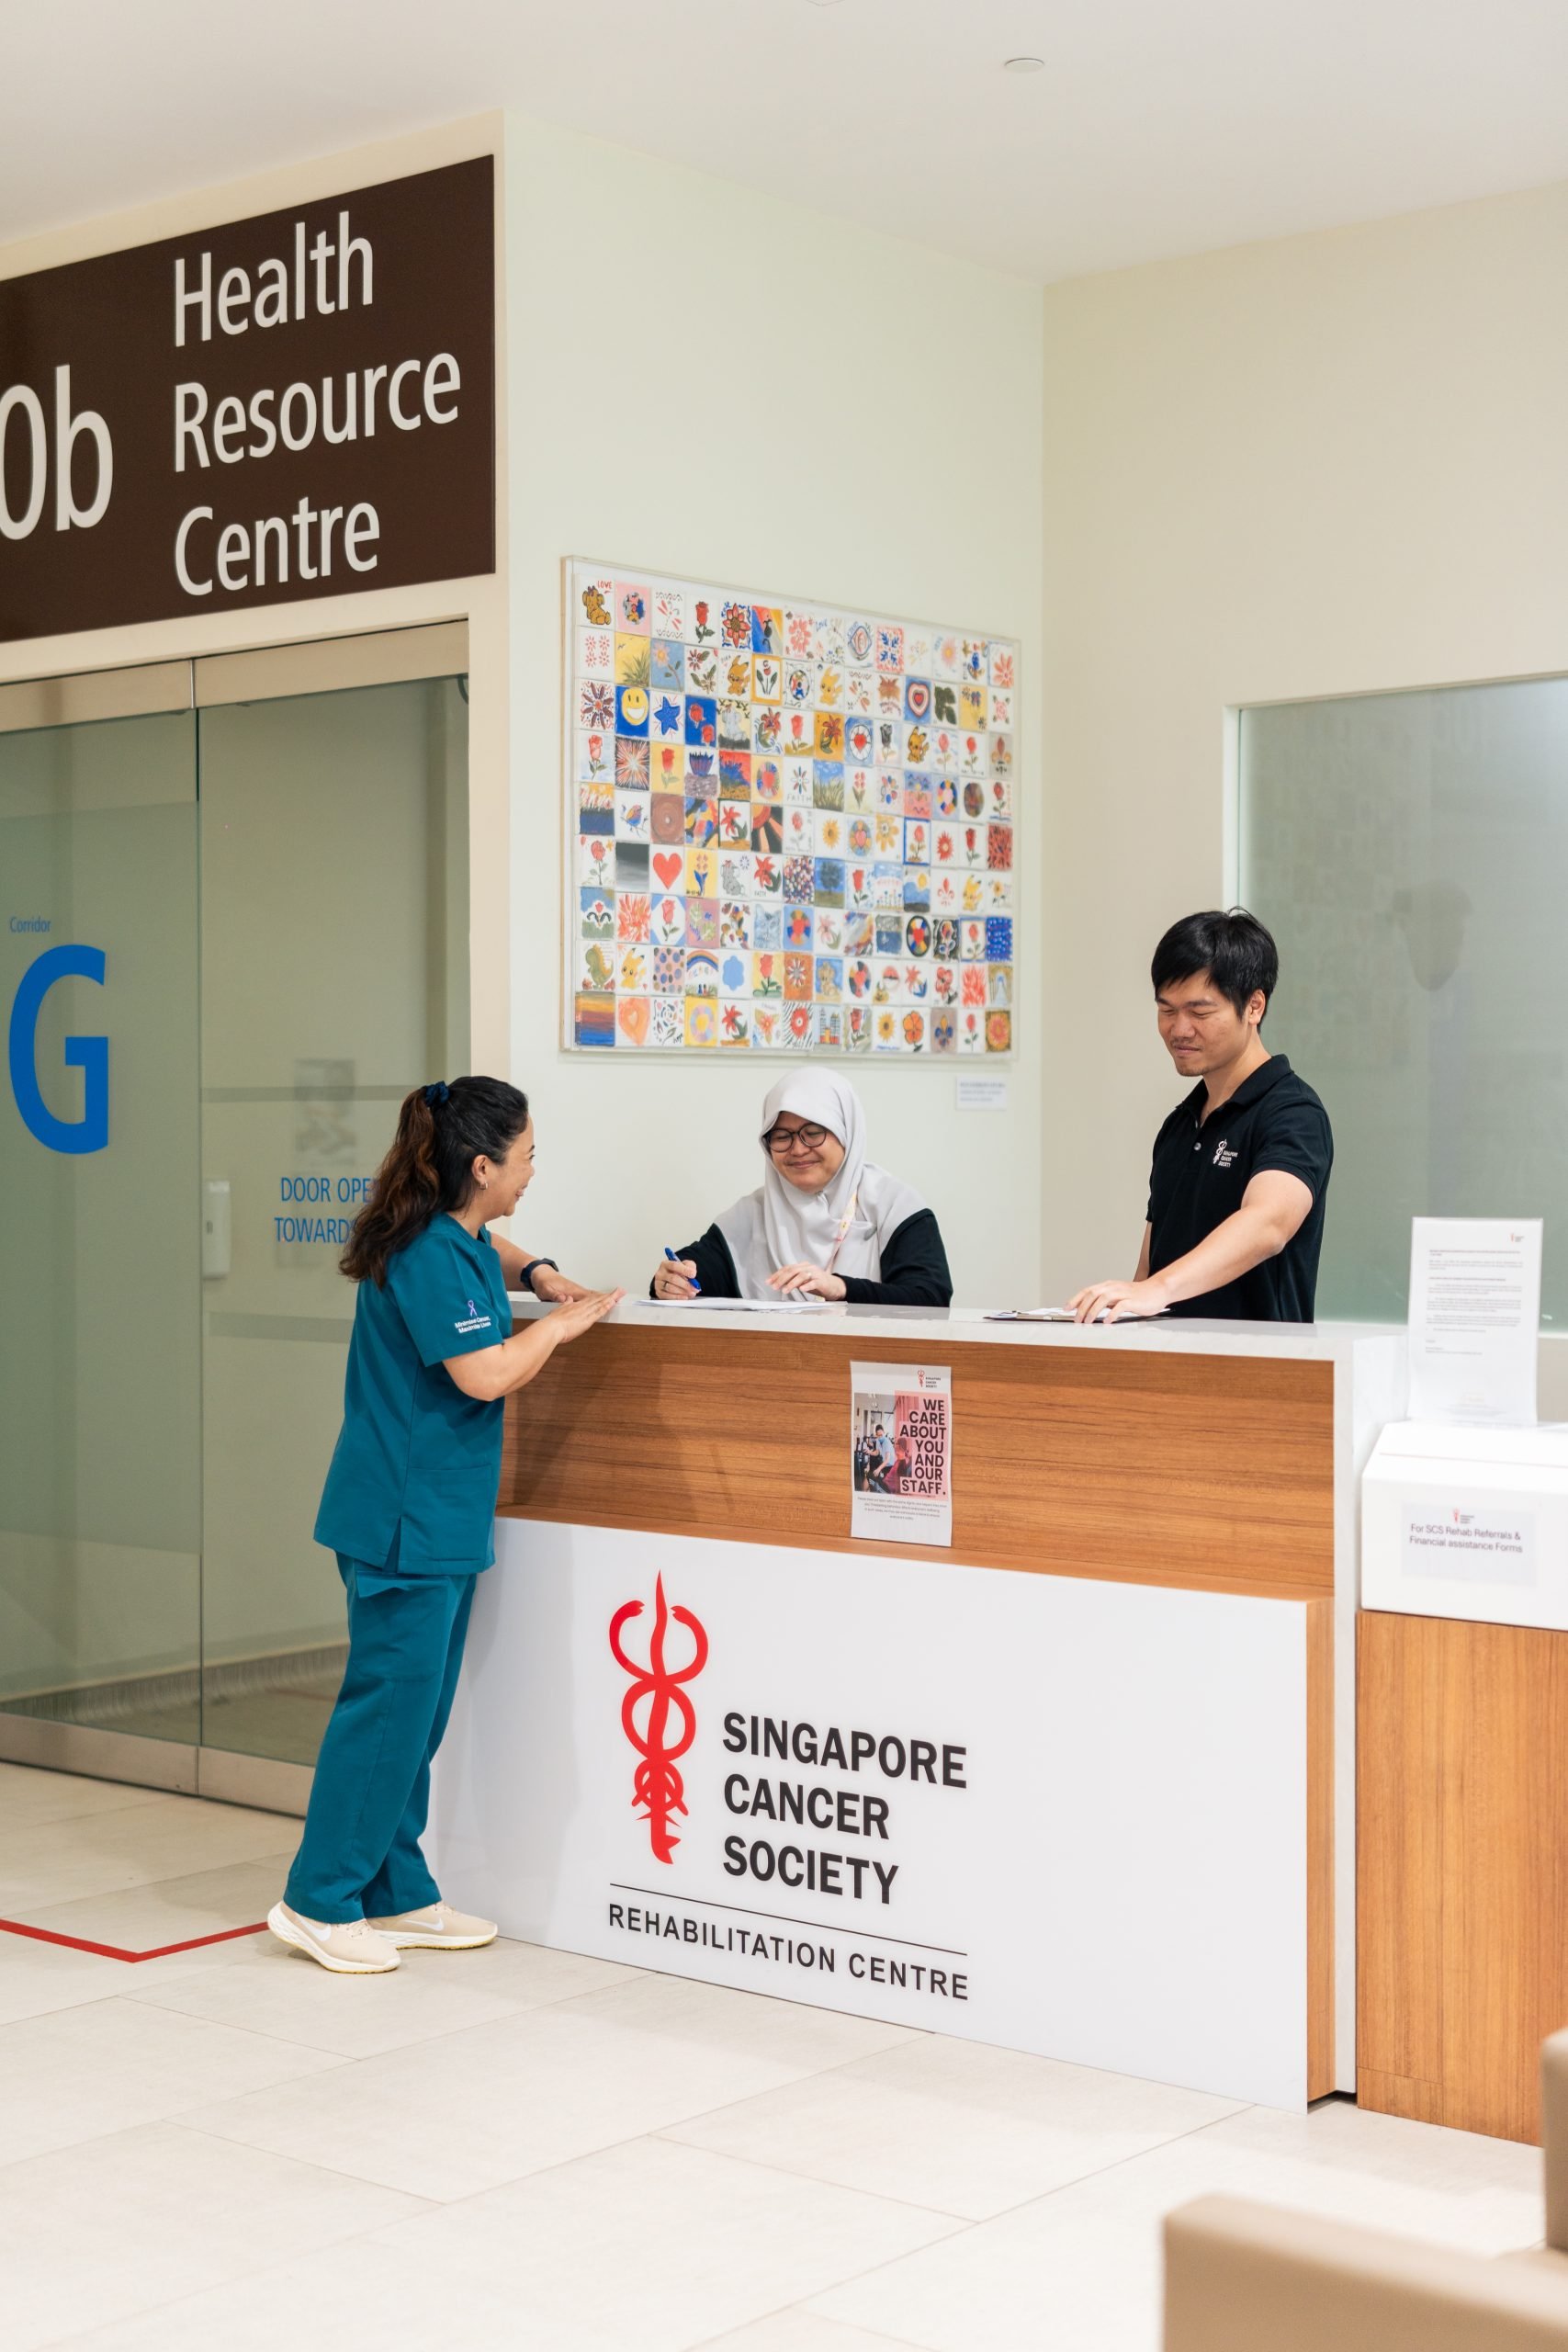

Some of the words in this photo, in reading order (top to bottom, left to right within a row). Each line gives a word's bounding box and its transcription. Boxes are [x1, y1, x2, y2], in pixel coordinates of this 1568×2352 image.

[175, 211, 373, 347] Health
[175, 353, 461, 472] Resource
[175, 497, 380, 595] Centre
[597, 581, 613, 589] LOVE
[9, 916, 51, 933] Corridor
[9, 944, 108, 1155] G
[281, 1177, 331, 1203] DOOR
[337, 1178, 376, 1204] OPE
[923, 1398, 944, 1411] WE
[908, 1411, 945, 1425] CARE
[900, 1424, 946, 1440] ABOUT
[915, 1440, 943, 1453] YOU
[915, 1453, 943, 1467] AND
[915, 1466, 942, 1481] OUR
[901, 1479, 946, 1495] STAFF.
[1411, 1523, 1423, 1533] For
[1426, 1524, 1444, 1534] SCS
[1445, 1526, 1472, 1537] Rehab
[1474, 1528, 1512, 1540] Referrals
[1514, 1532, 1521, 1540] &
[1409, 1535, 1446, 1547] Financial
[1448, 1539, 1494, 1551] assistance
[1495, 1543, 1523, 1553] Forms
[723, 1712, 967, 1789] SINGAPORE
[724, 1774, 889, 1840] CANCER
[723, 1835, 899, 1905] SOCIETY
[609, 1903, 836, 1973] REHABILITATION
[849, 1952, 968, 2001] CENTRE
